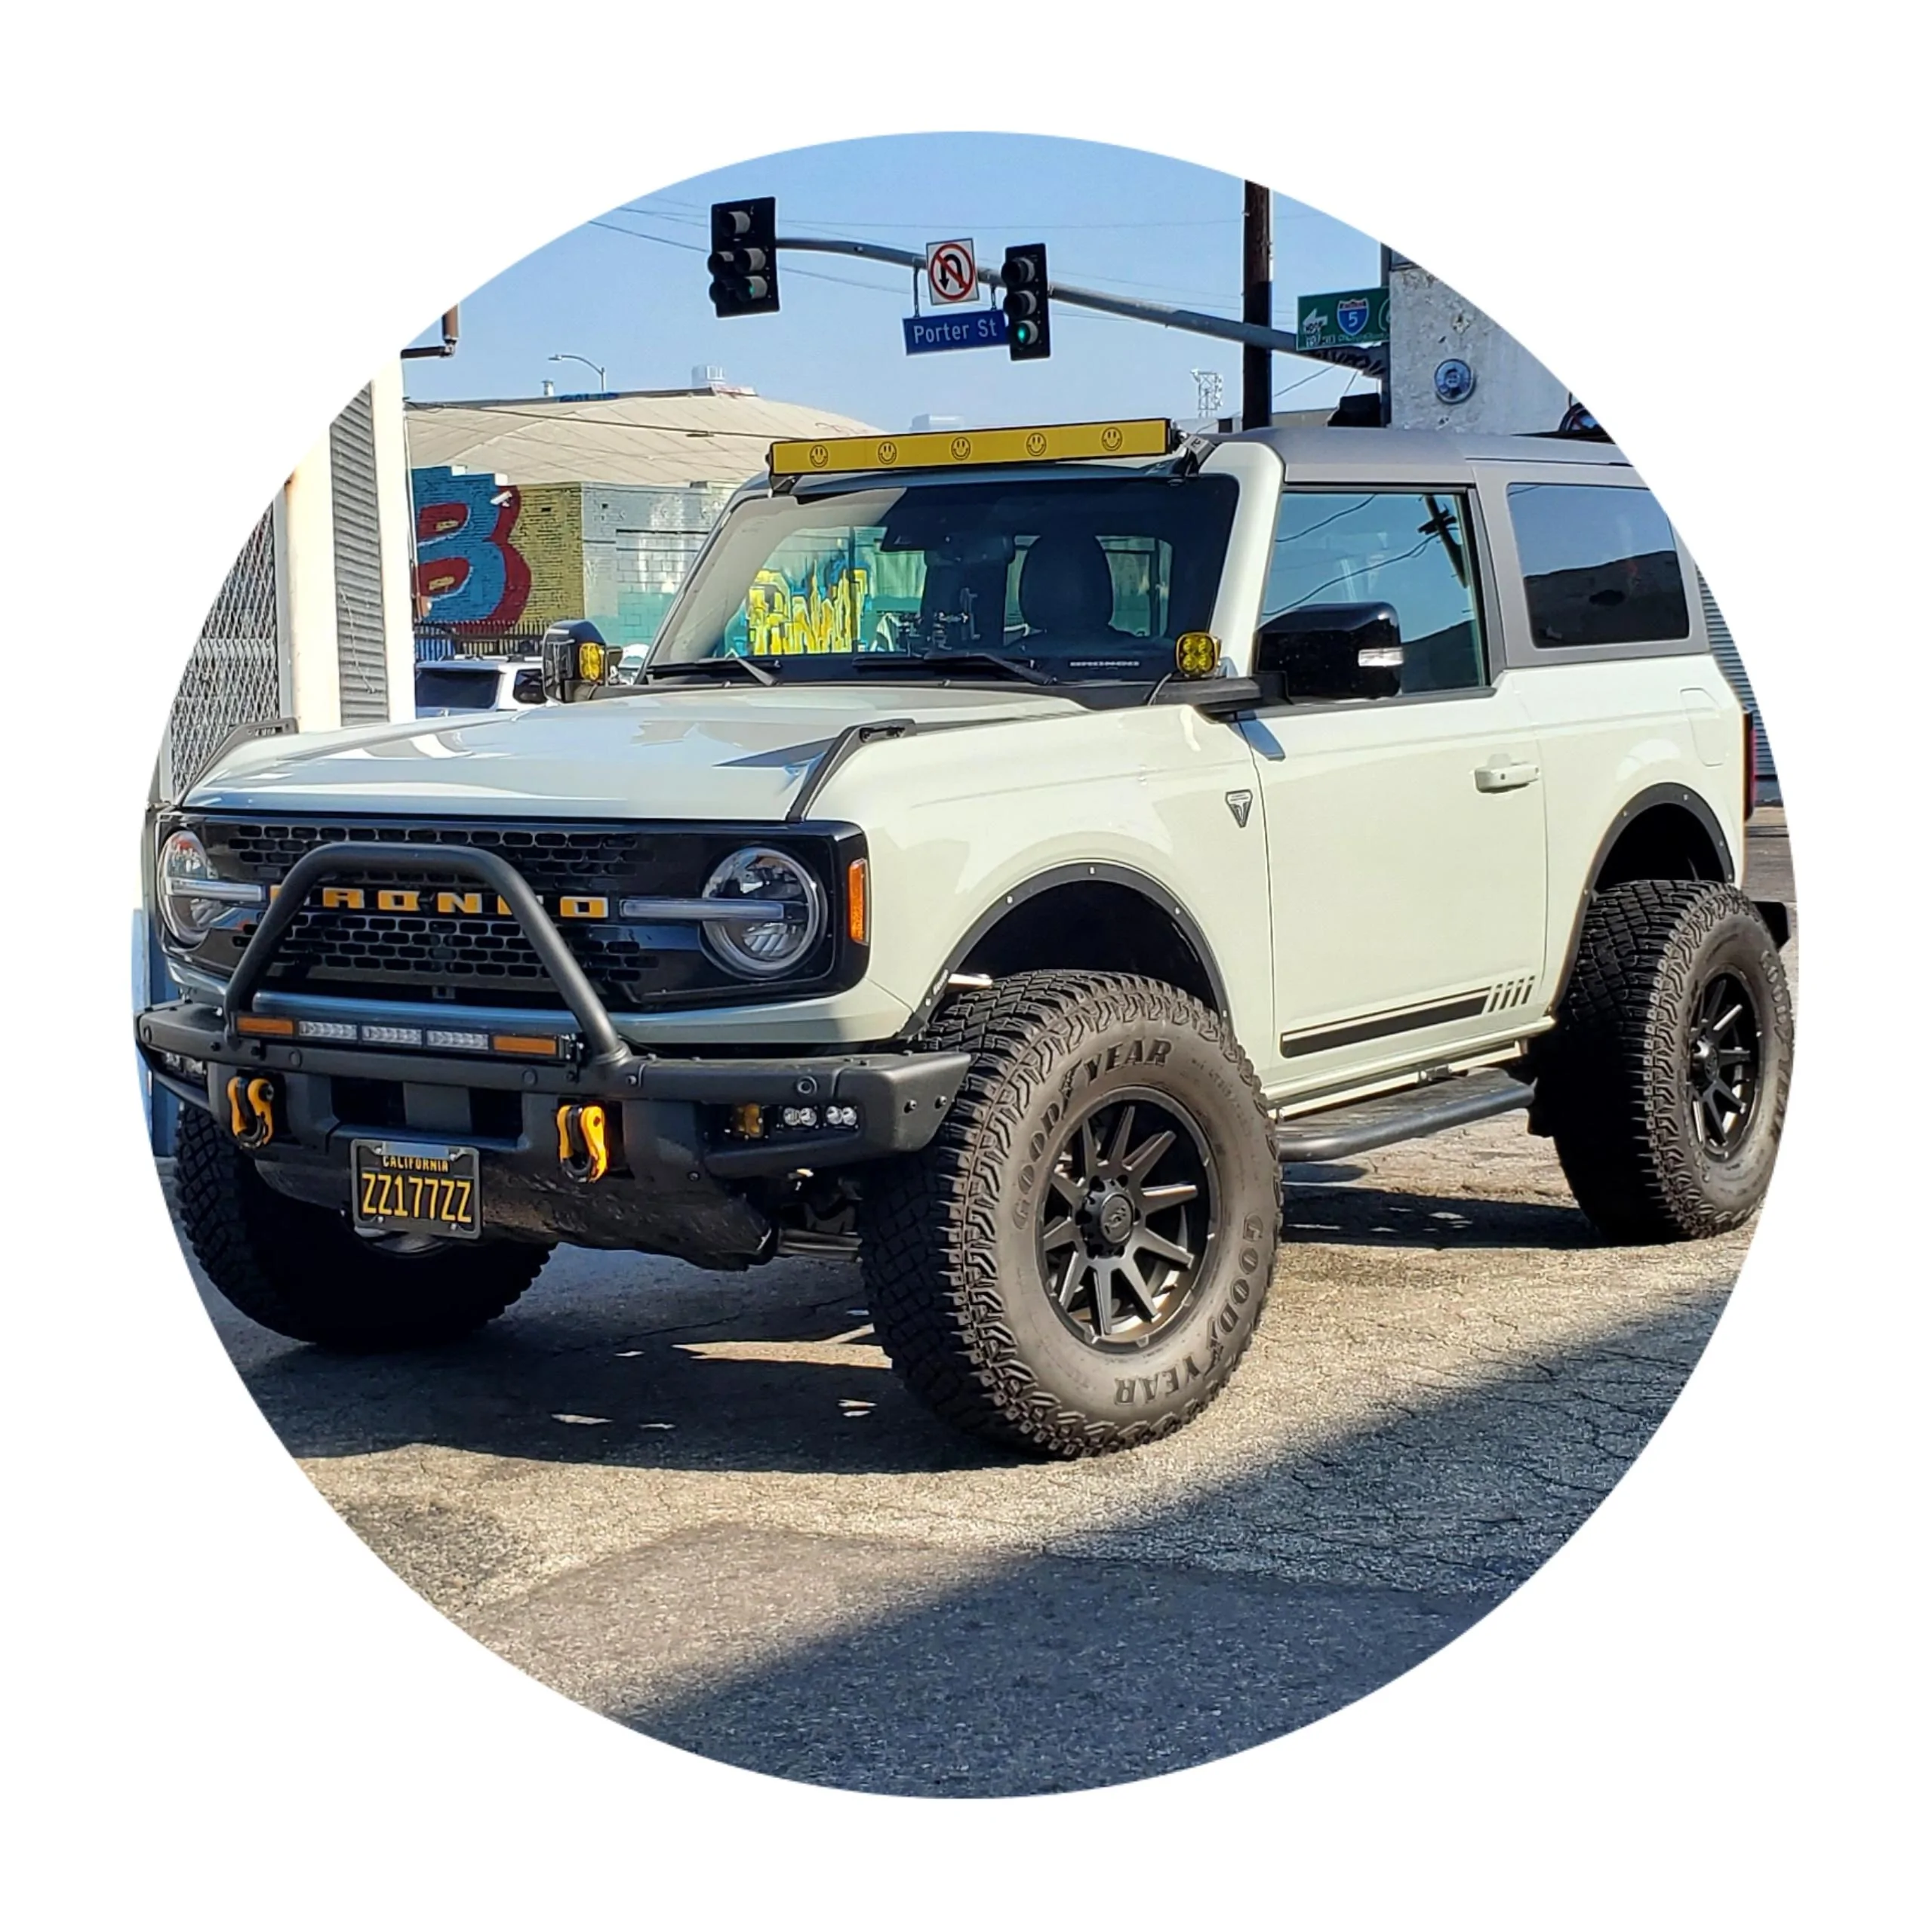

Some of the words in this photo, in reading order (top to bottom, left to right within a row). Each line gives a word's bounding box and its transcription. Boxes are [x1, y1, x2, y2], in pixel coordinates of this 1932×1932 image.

[913, 322, 970, 344] Porter
[977, 318, 998, 337] St
[1348, 311, 1358, 328] 5
[270, 884, 608, 918] RONO
[1012, 1037, 1173, 1231] GOODYEAR
[382, 1155, 449, 1173] CALIFORNIA
[361, 1172, 472, 1223] ZZ177ZZ
[1114, 1212, 1265, 1406] GOODYEAR
